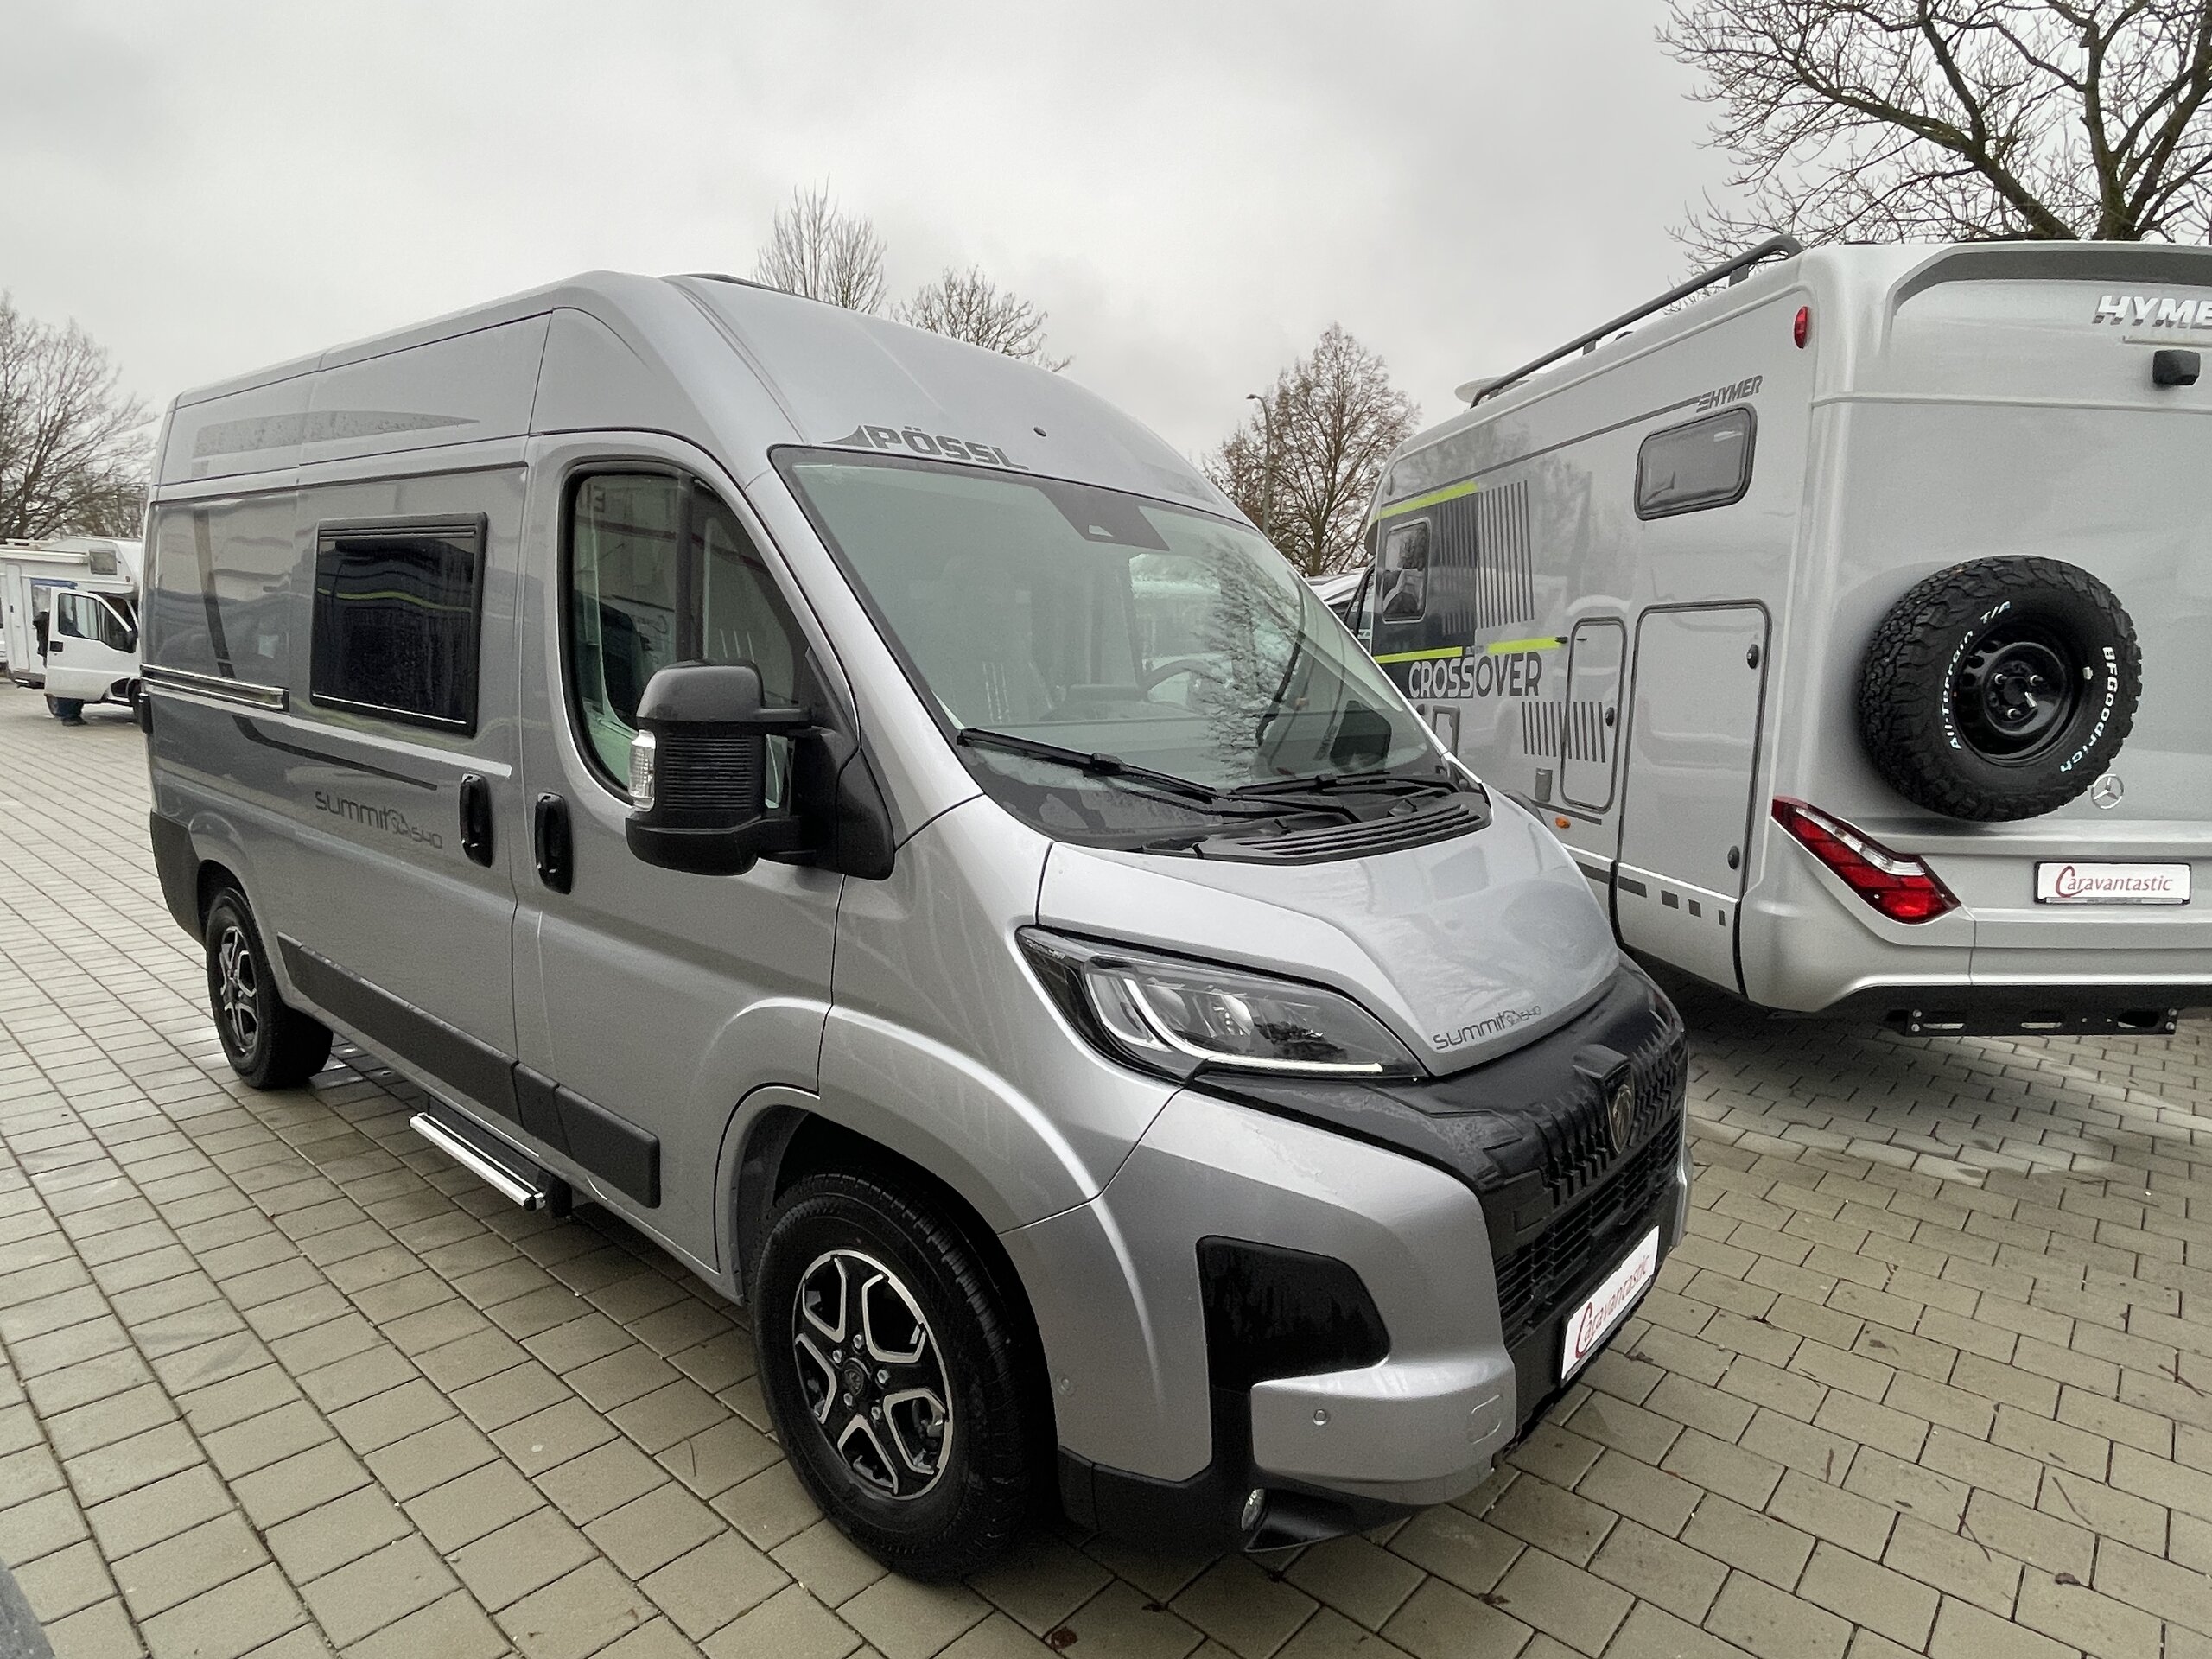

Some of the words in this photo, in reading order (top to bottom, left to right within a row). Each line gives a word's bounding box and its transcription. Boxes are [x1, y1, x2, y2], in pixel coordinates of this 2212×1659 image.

[1707, 375, 1764, 410] HYMER
[863, 424, 1030, 471] PÖSSL
[1408, 652, 1543, 698] CROSSOVER
[410, 826, 443, 849] 540
[2055, 865, 2174, 898] Caravantastic
